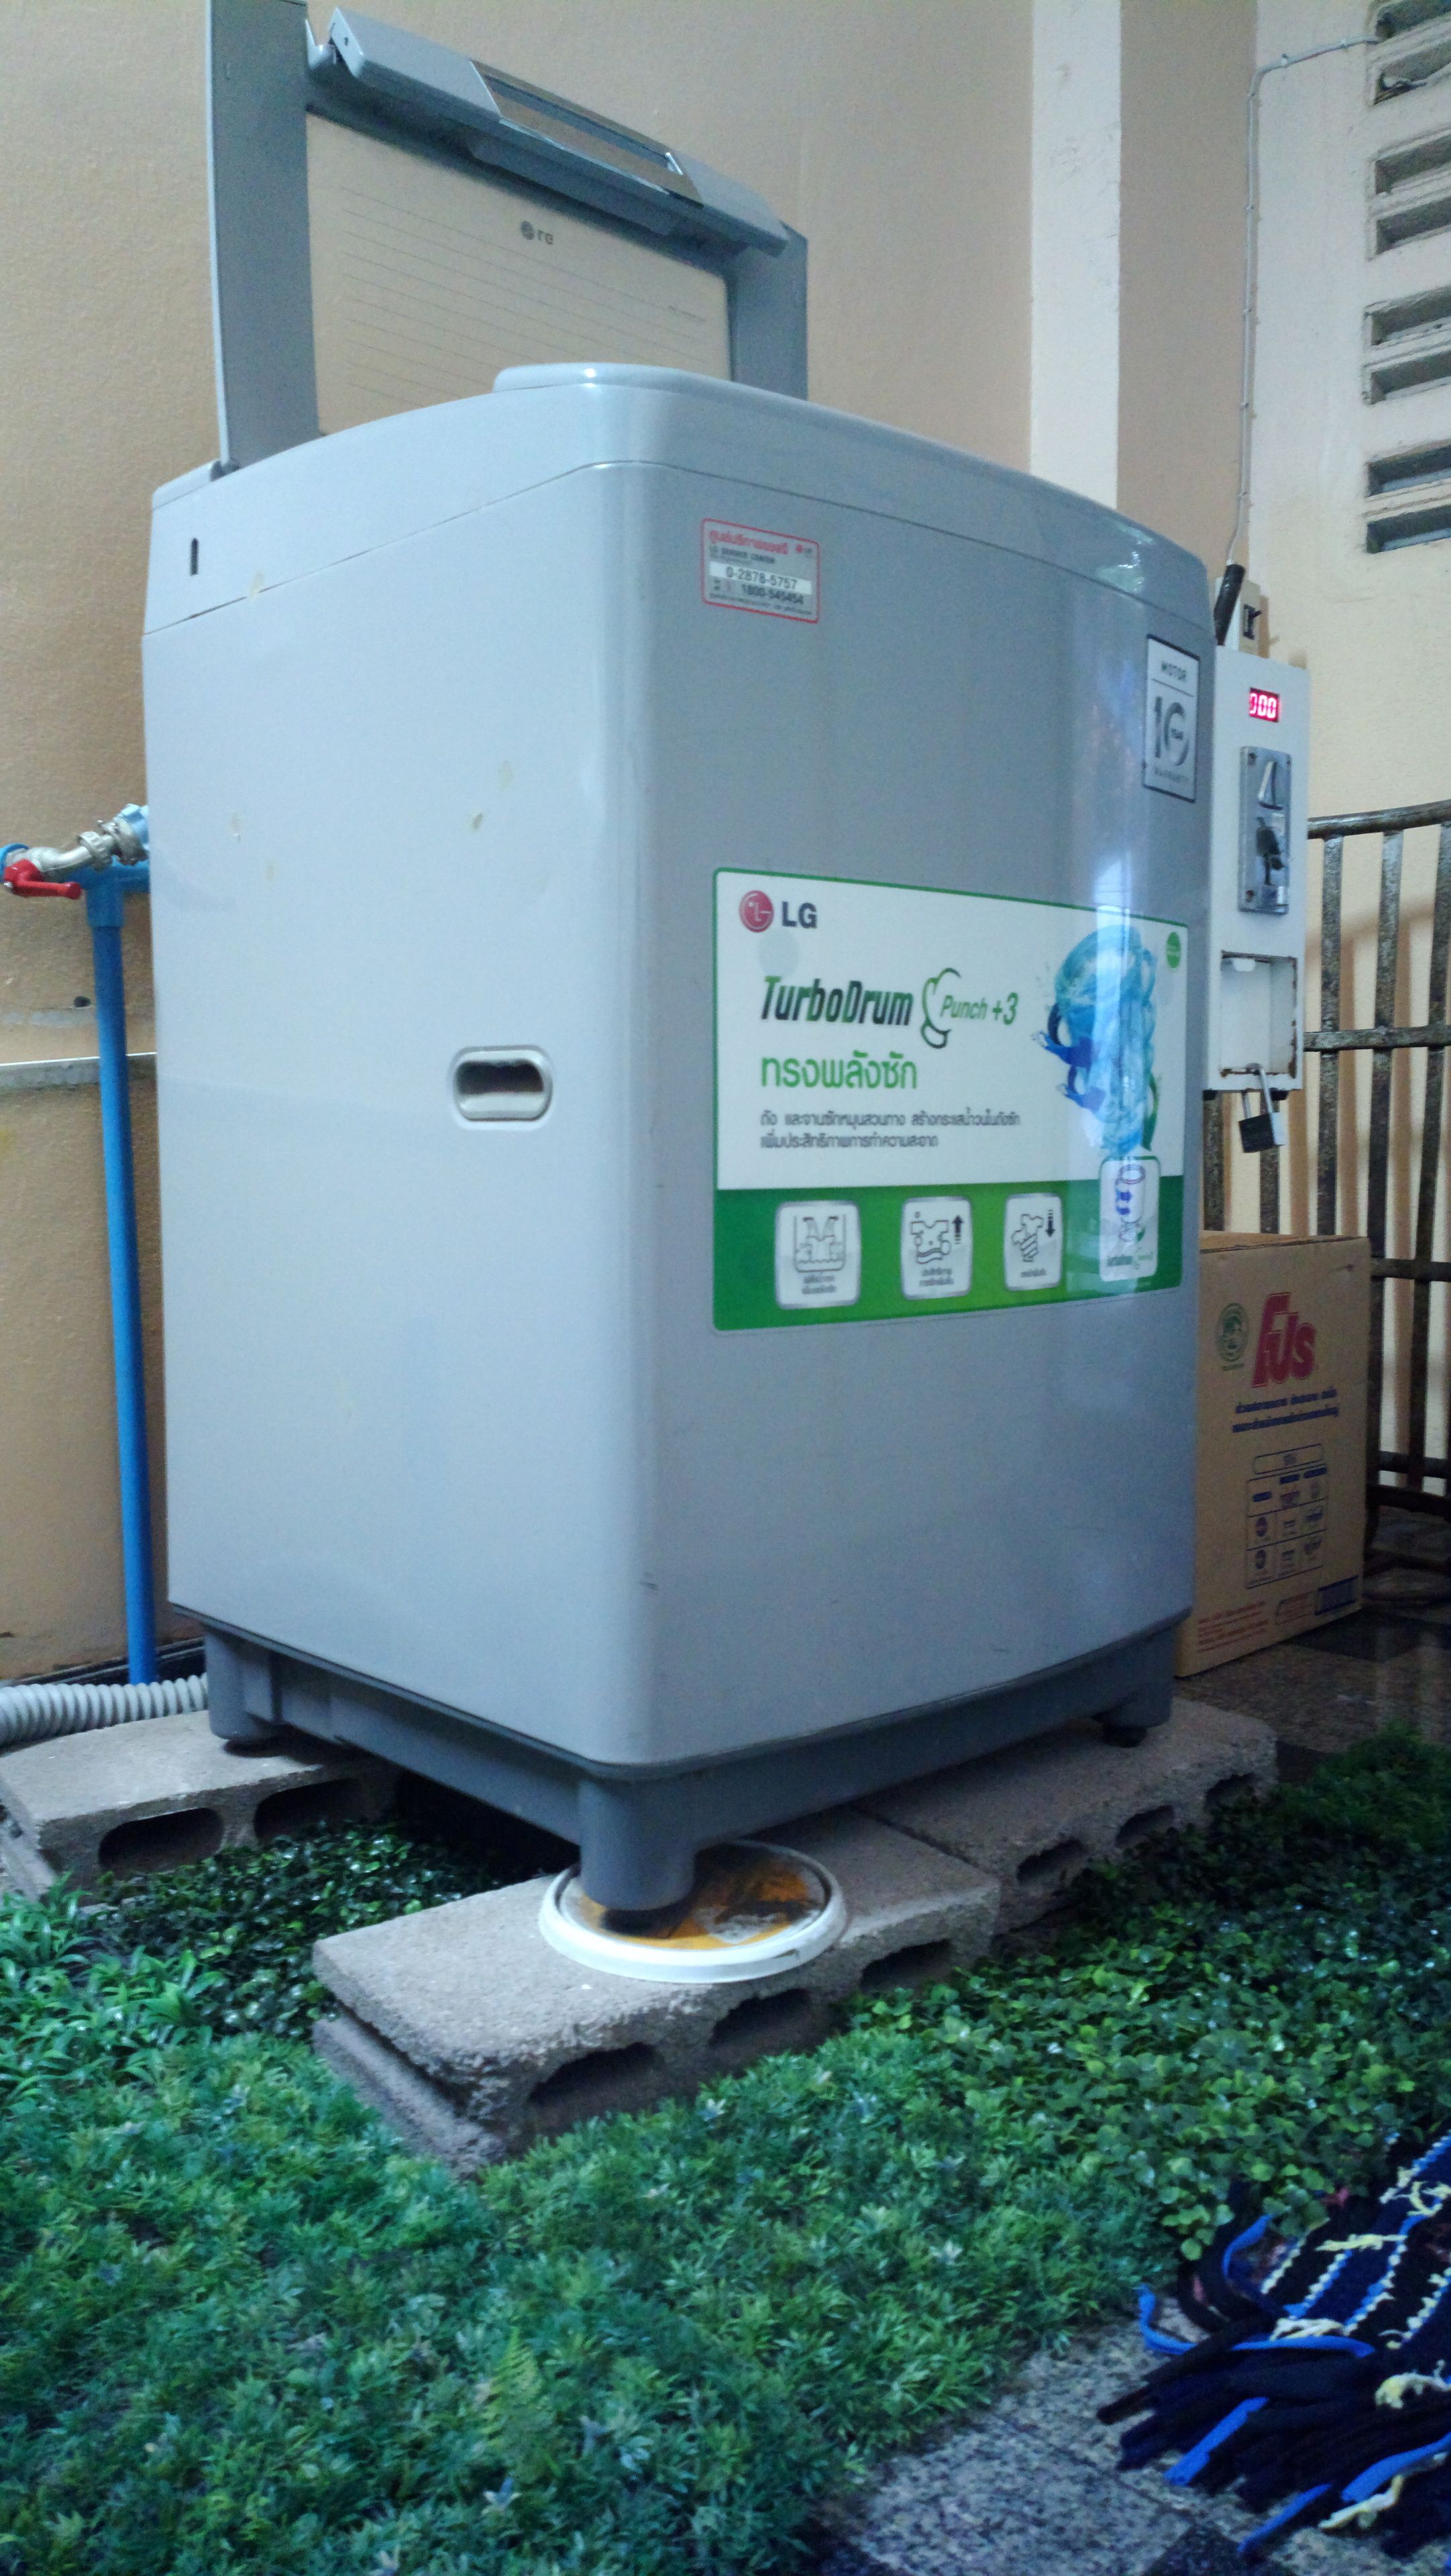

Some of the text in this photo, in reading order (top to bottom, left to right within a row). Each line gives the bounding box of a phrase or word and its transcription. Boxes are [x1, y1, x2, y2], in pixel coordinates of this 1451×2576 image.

[726, 566, 797, 590] 0-2878-5757
[782, 902, 818, 929] LG
[761, 975, 914, 1026] TurboDrum
[940, 994, 988, 1020] Punch
[760, 1050, 917, 1089] ทรงพลังซัก
